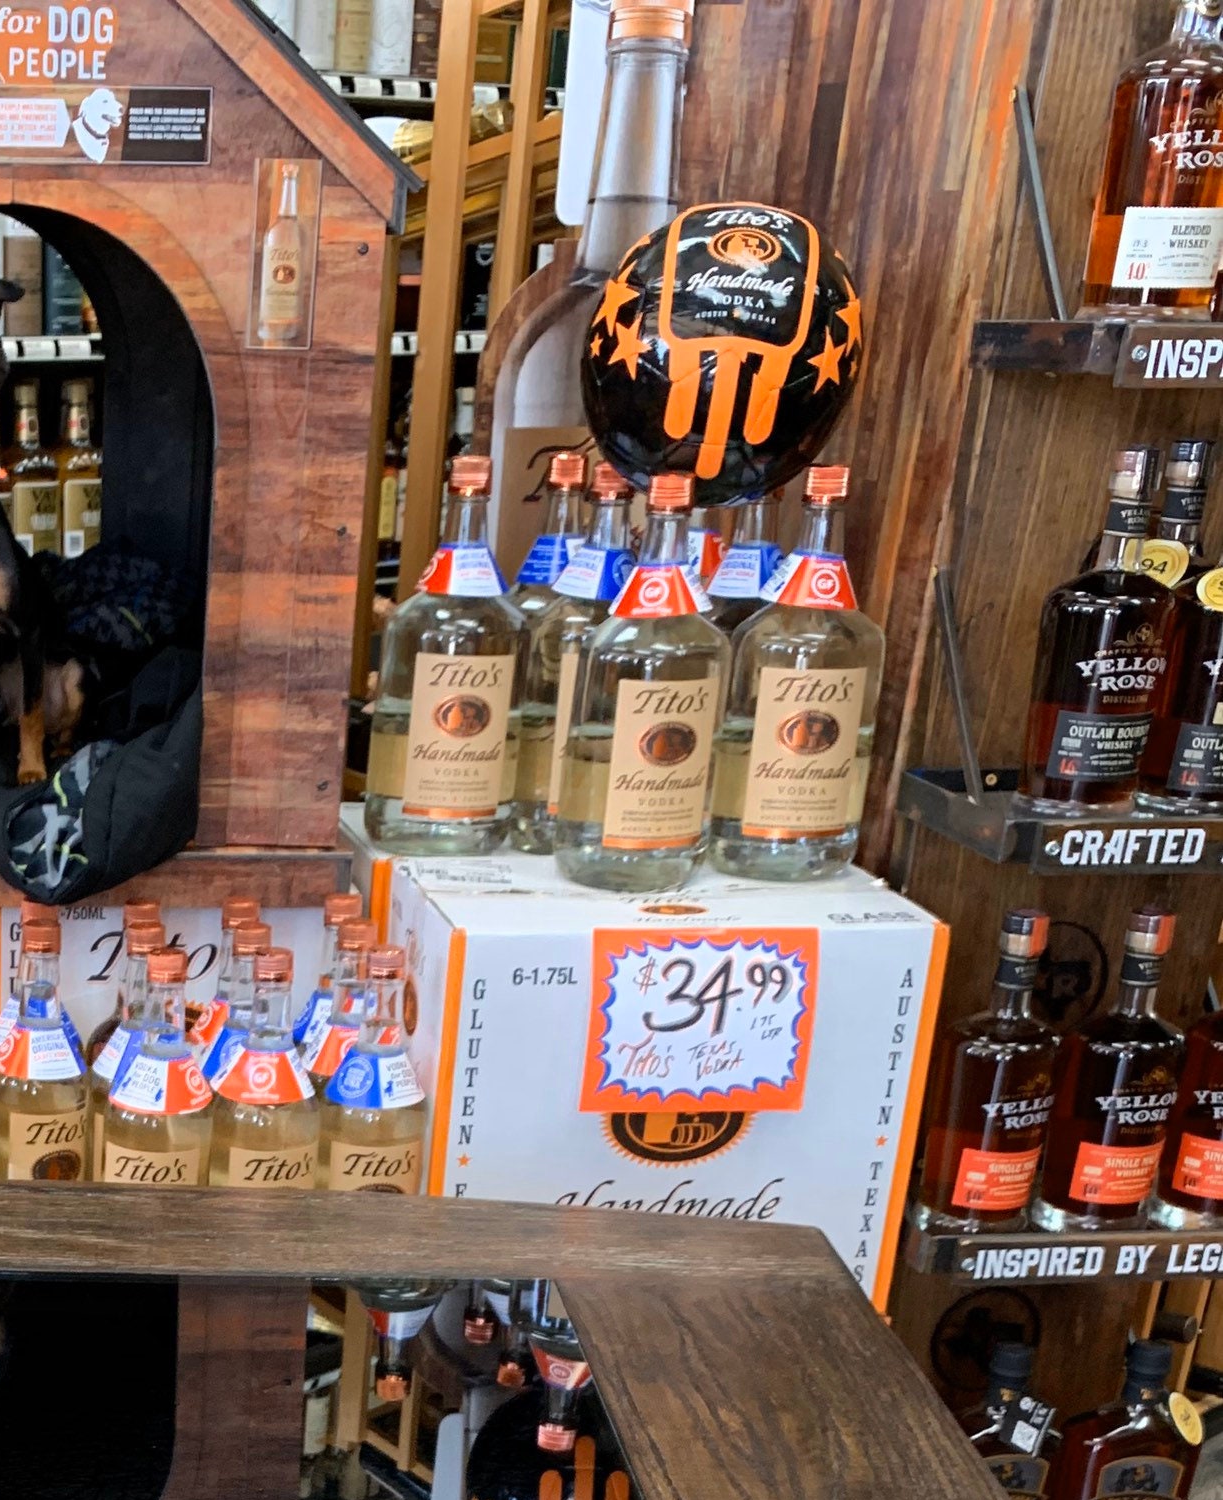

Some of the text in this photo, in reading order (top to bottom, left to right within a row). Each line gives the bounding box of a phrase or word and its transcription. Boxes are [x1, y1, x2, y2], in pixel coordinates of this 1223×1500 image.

[48, 6, 113, 44] DOG
[9, 47, 106, 80] PEOPLE
[704, 209, 794, 232] Tito's
[1171, 225, 1211, 236] BLENDED
[1169, 239, 1210, 249] WHISKEY
[685, 266, 795, 297] Handmade
[1141, 558, 1168, 574] 94
[429, 661, 503, 688] Tito's
[1099, 674, 1156, 691] ROSE
[633, 685, 710, 714] Tito's
[773, 675, 855, 702] Tito's
[1069, 725, 1114, 739] OUTLAW
[1096, 740, 1134, 750] WHISKEY
[434, 768, 479, 777] VODKA
[638, 797, 685, 807] VODKA
[777, 786, 827, 796] VODKA
[1059, 828, 1206, 865] CRAFTED
[512, 966, 578, 985] 6-1.75L
[877, 969, 914, 1126] AUSTIN
[458, 978, 487, 1146] GLUTEN
[143, 1074, 160, 1087] DOG
[1118, 1108, 1169, 1124] ROSE
[26, 1115, 87, 1145] Tito's
[114, 1155, 187, 1183] Tito's
[244, 1153, 314, 1182] Tito's
[343, 1150, 416, 1179] Tito's
[854, 1162, 883, 1284] TEXAS
[973, 1246, 1105, 1280] INSPIRED
[1115, 1244, 1157, 1275] BY
